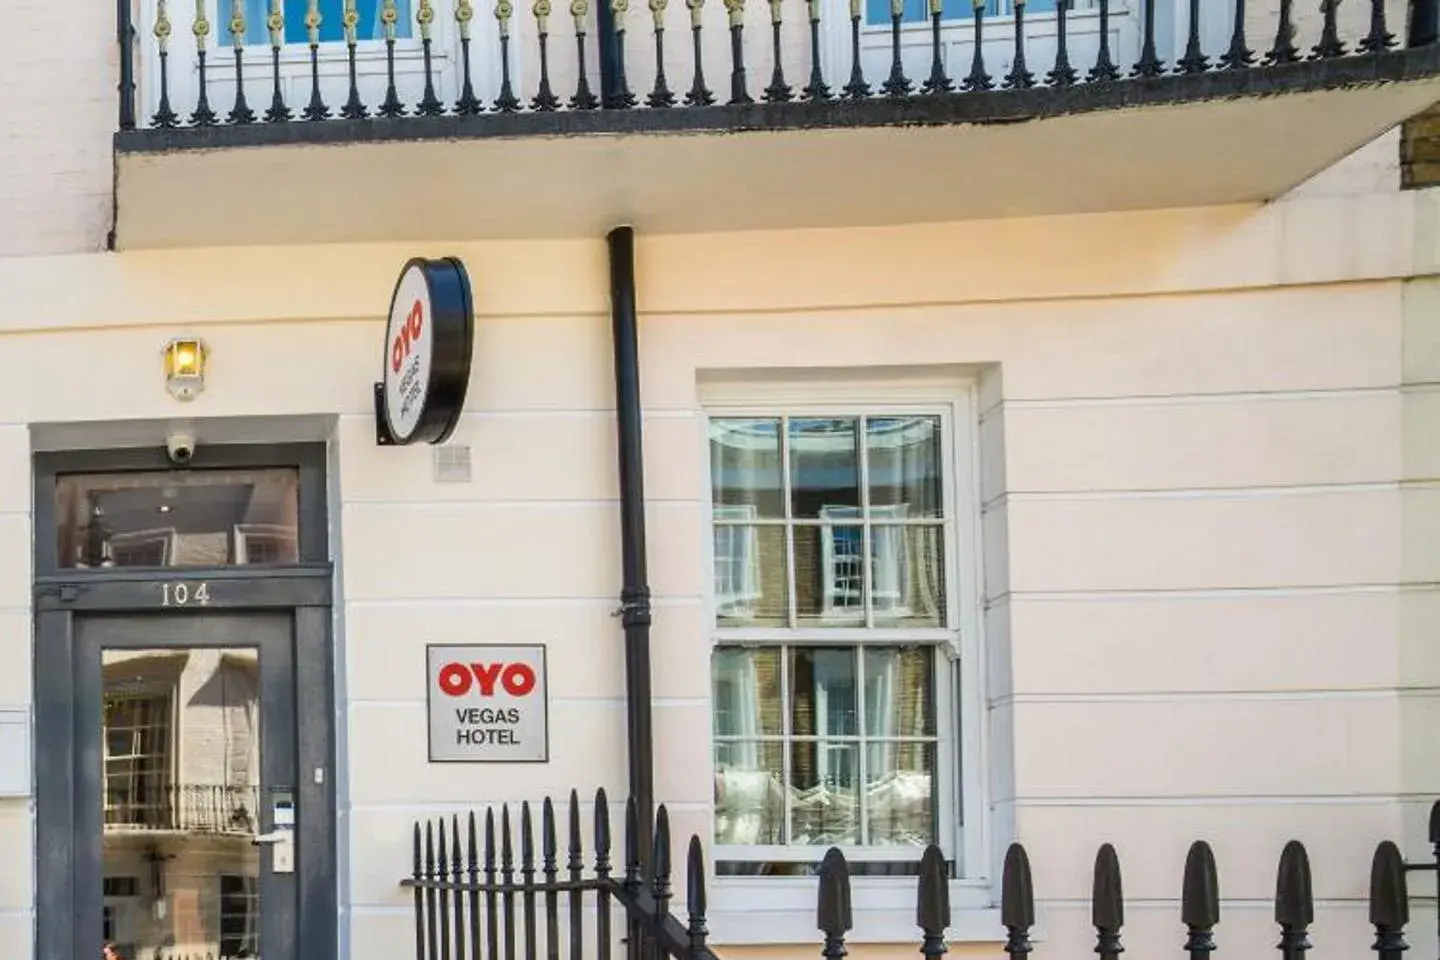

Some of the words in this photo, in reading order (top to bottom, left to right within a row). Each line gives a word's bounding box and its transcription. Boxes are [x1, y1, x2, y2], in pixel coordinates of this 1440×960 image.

[391, 299, 423, 373] OYO
[161, 582, 210, 606] 104
[438, 661, 536, 697] OYO
[455, 707, 520, 724] VEGAS
[456, 729, 521, 744] HOTEL
